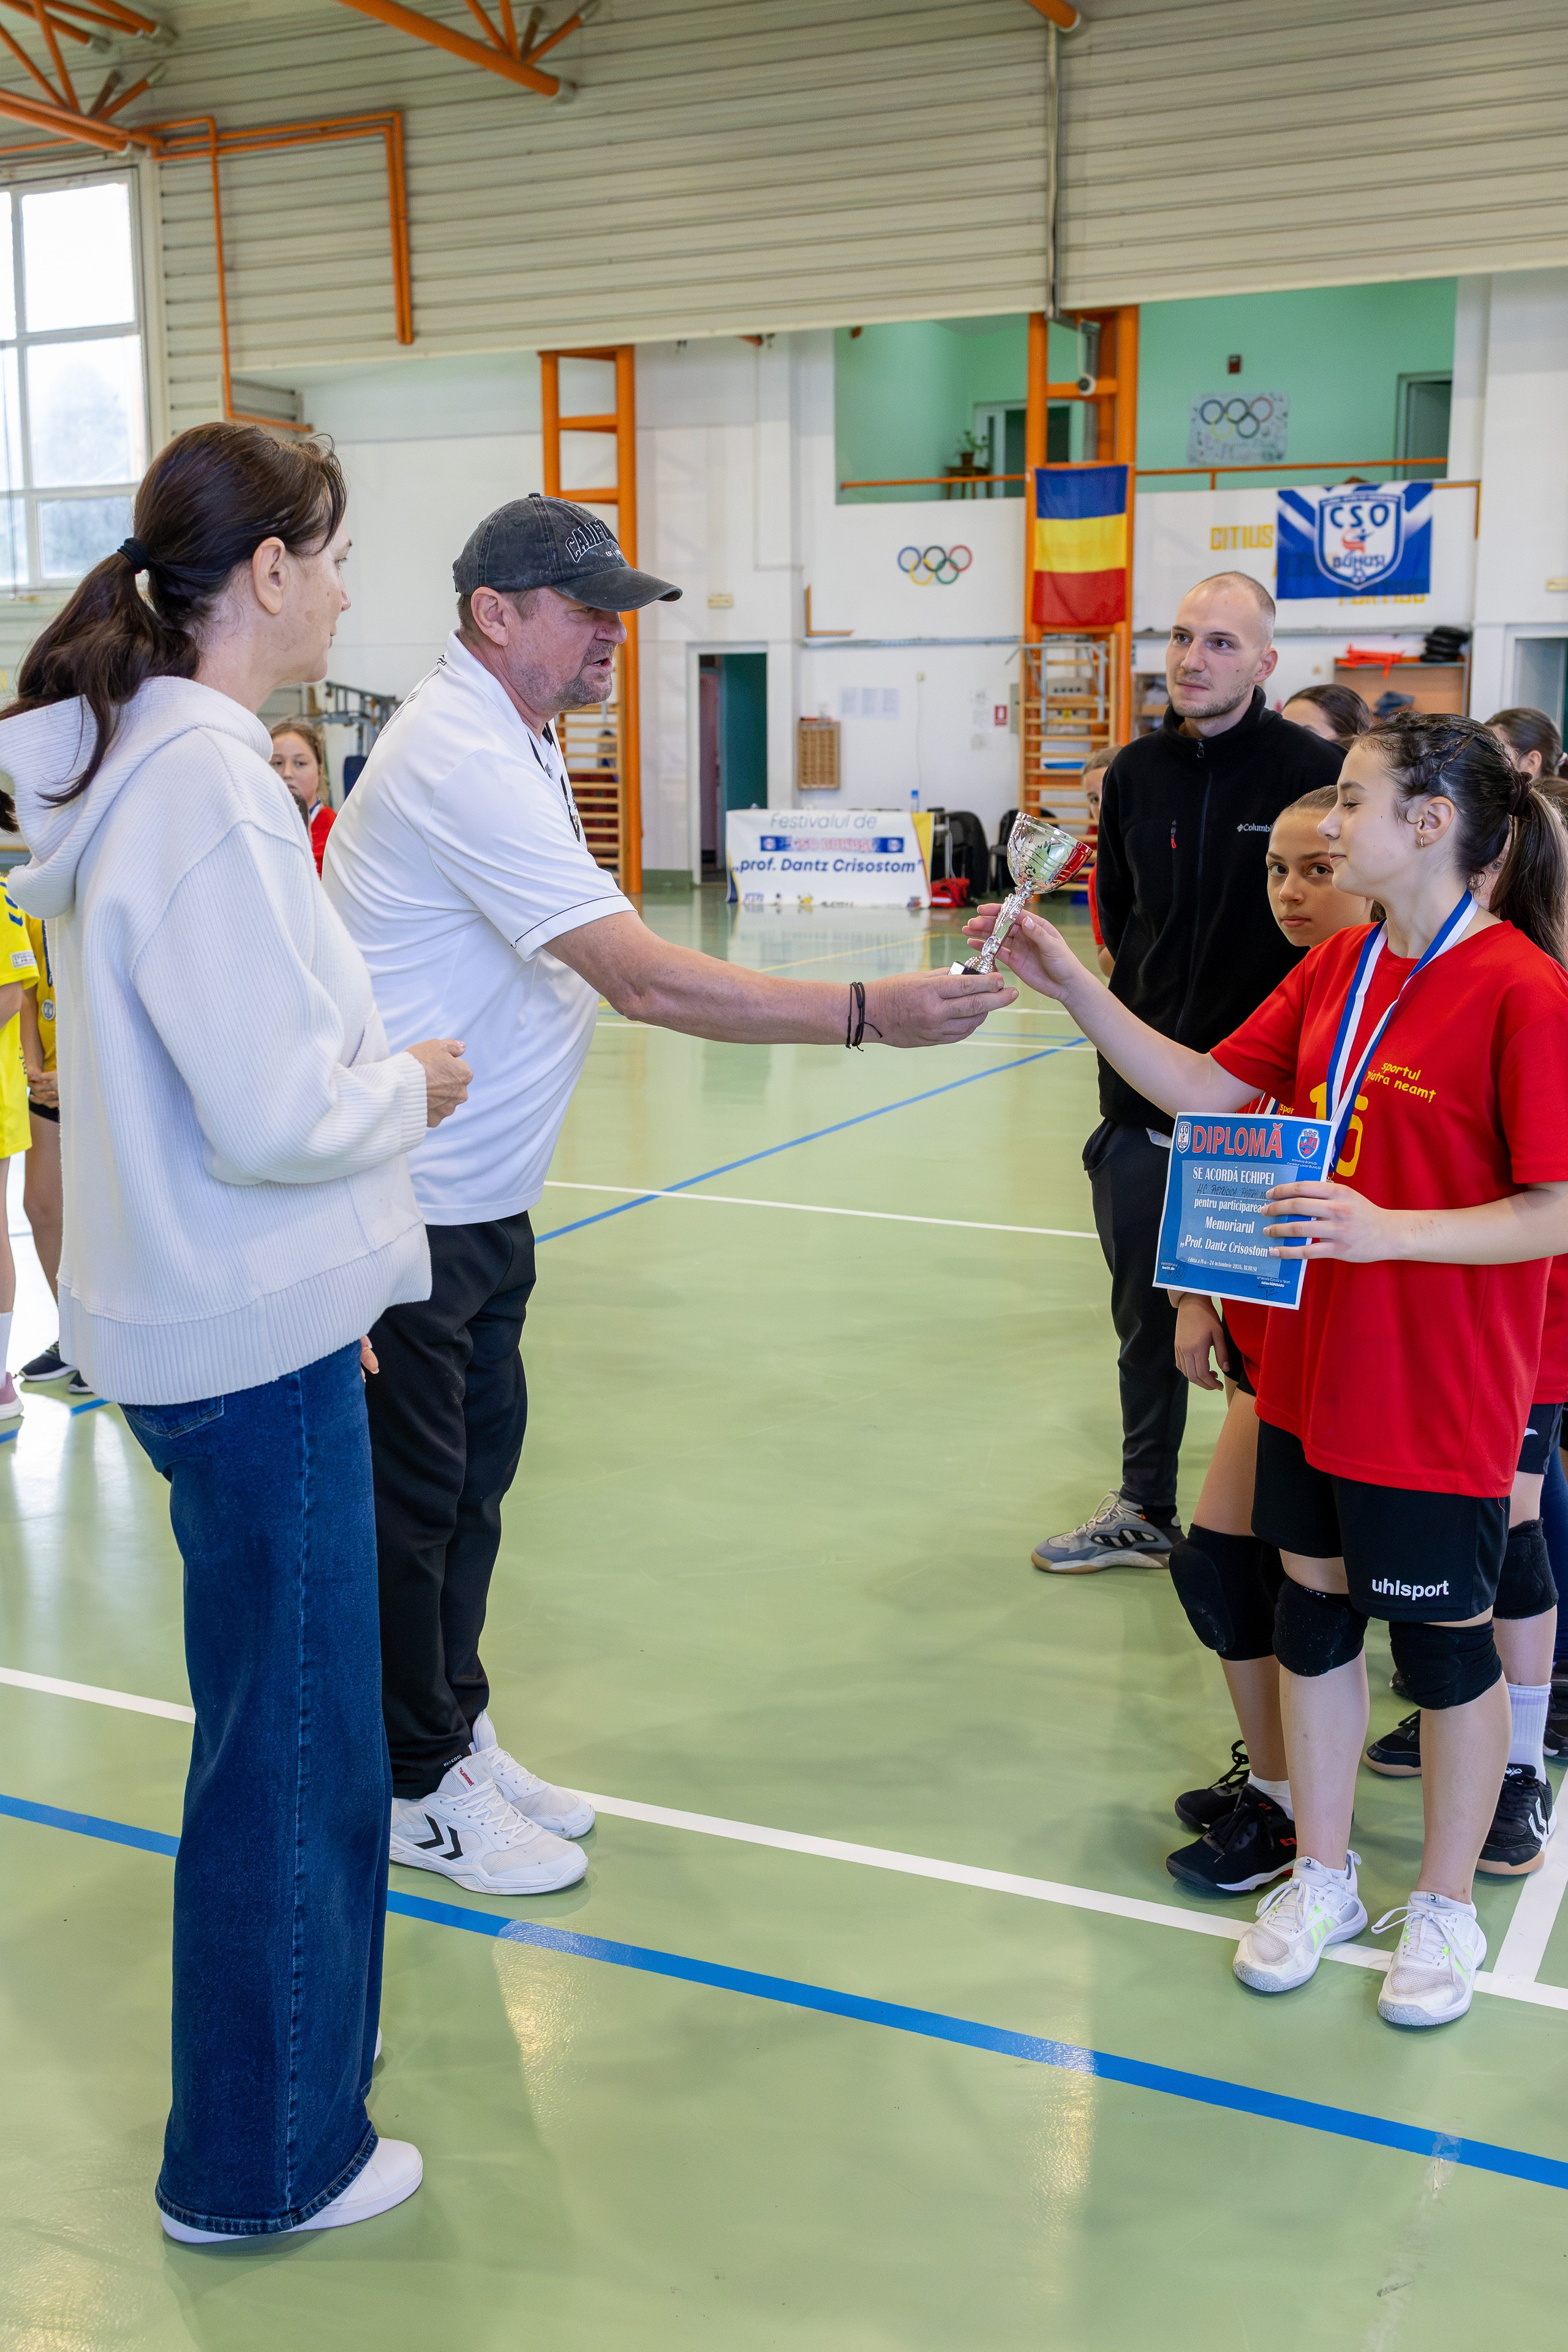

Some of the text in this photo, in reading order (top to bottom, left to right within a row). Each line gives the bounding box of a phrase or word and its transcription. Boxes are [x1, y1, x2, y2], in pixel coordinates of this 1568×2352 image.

[1330, 504, 1389, 527] CSO
[1210, 524, 1273, 551] CITIUS
[771, 813, 877, 829] Festivalul de
[781, 859, 827, 872] Dantz
[1381, 1063, 1421, 1081] sportul
[1394, 1080, 1436, 1102] neamț
[1192, 1123, 1283, 1158] DIPLOMĂ
[1193, 1166, 1275, 1185] SE ACORDĂ ECHIPEI
[1194, 1197, 1262, 1214] pentru participarea
[1205, 1215, 1255, 1234] Memoriarul
[1205, 1238, 1227, 1252] Dantz
[1372, 1578, 1449, 1600] uhlsport
